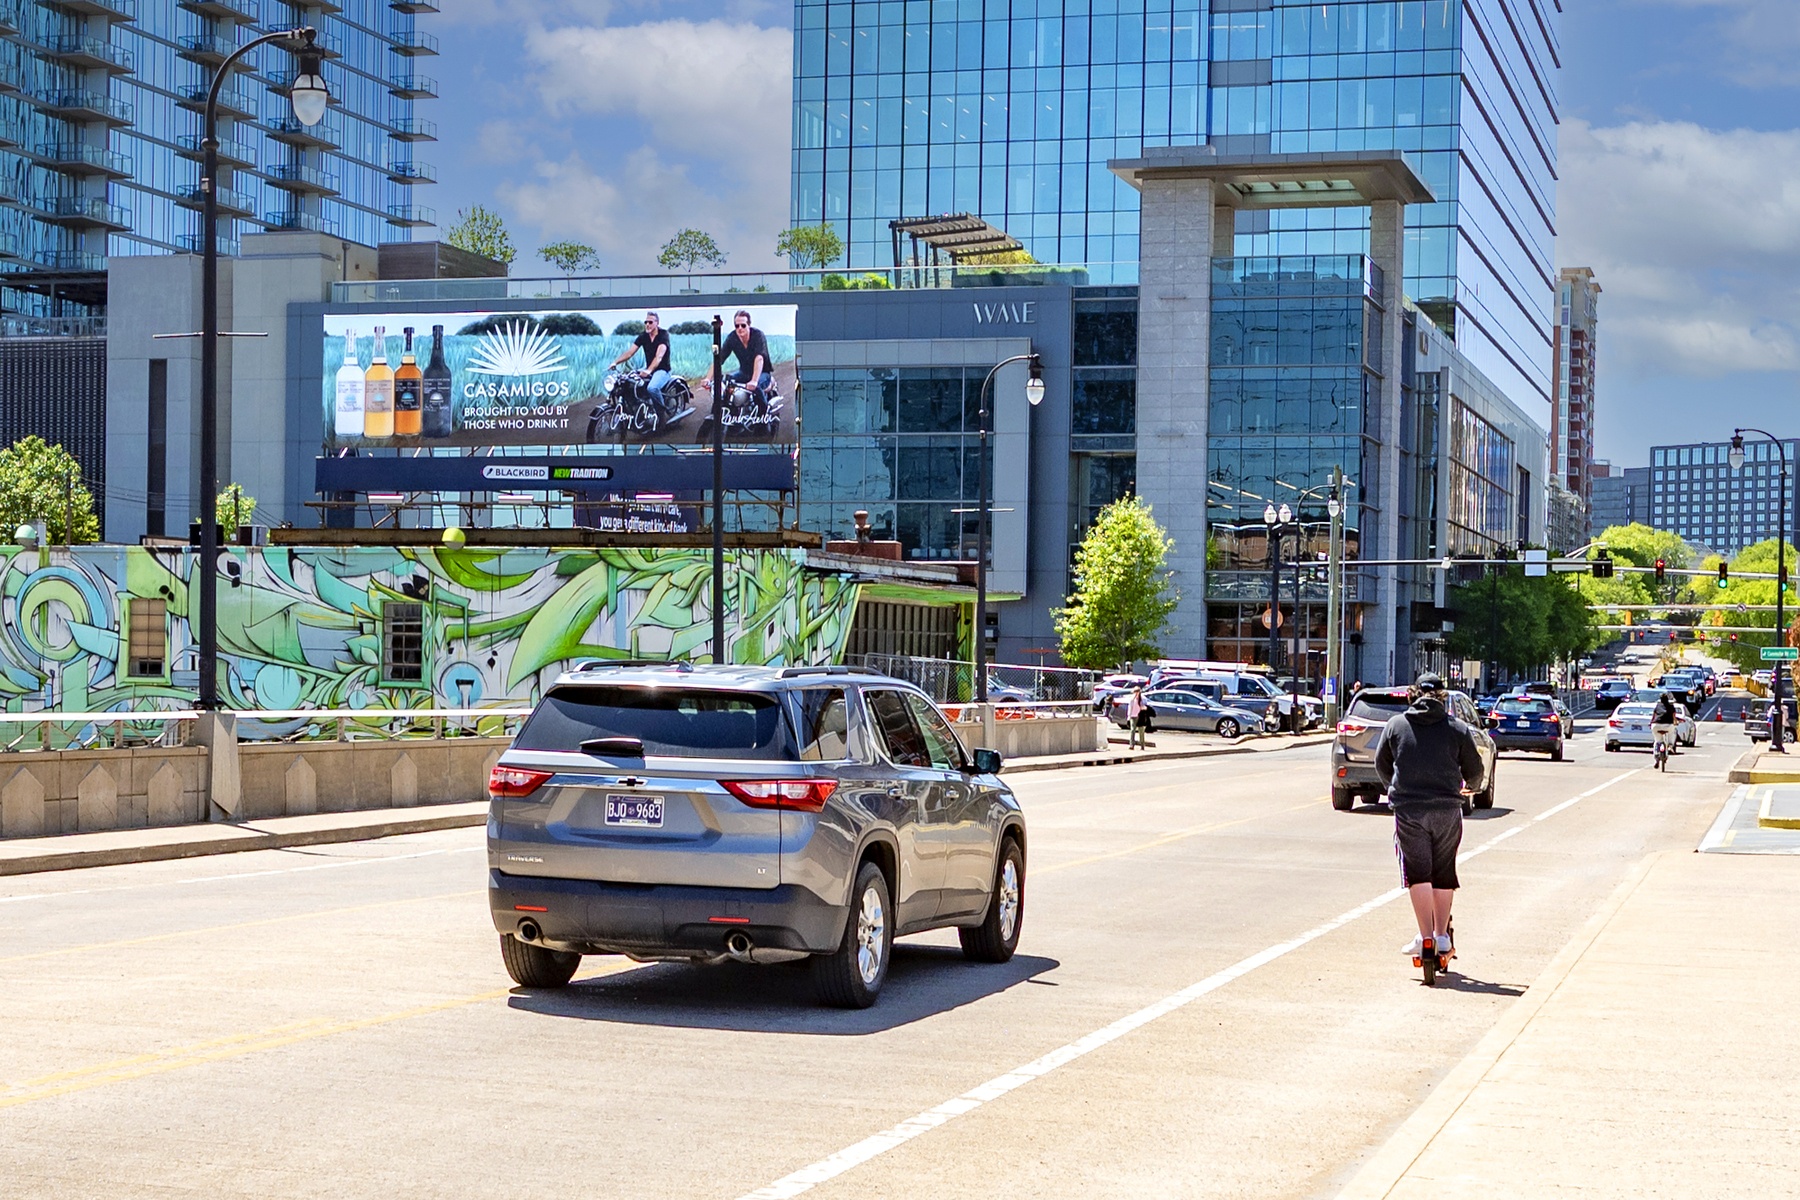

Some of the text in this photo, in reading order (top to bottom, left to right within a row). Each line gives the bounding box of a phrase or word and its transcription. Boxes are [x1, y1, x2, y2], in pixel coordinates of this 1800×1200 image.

[463, 381, 570, 398] CASAMIGOS
[464, 405, 569, 417] BROUGHT TO YOU BY
[464, 419, 570, 430] THOSE WHO DRINK IT
[495, 467, 546, 477] BLACKBIRD
[600, 516, 612, 531] you
[628, 516, 654, 533] different
[636, 803, 661, 819] 9683
